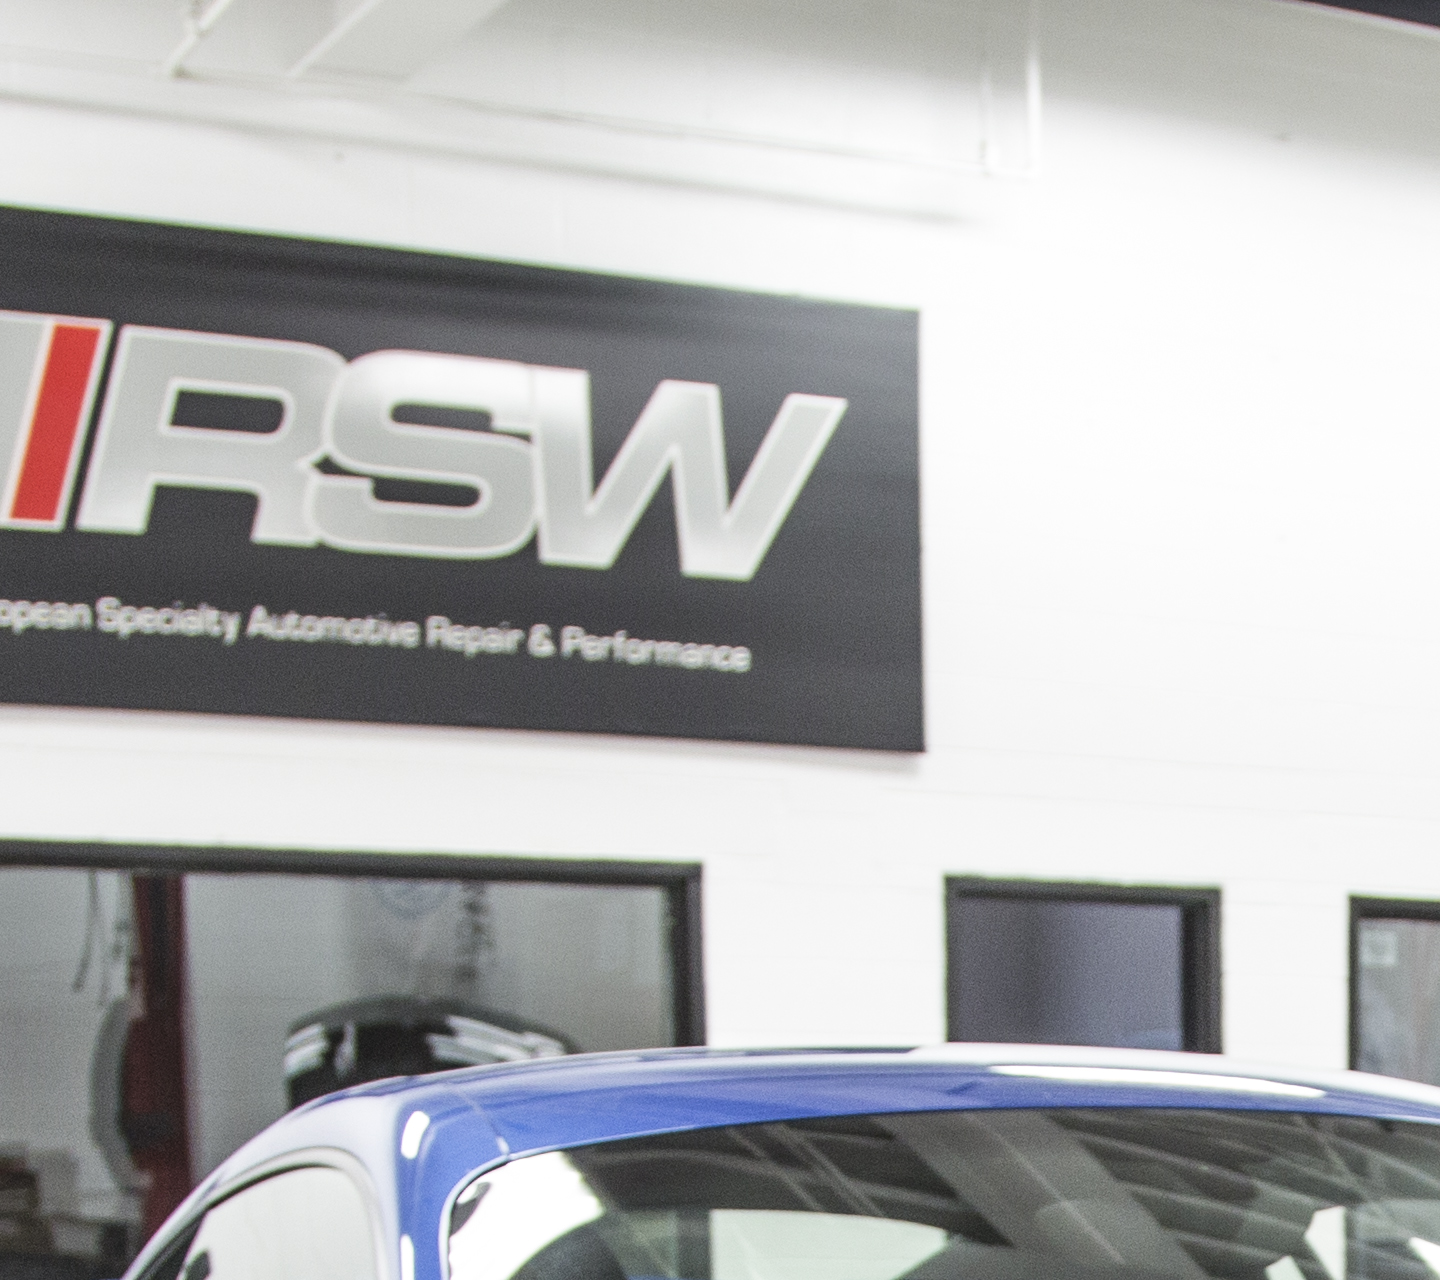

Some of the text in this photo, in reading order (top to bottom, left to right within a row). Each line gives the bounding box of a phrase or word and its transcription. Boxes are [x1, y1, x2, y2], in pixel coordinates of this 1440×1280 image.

[75, 324, 848, 581] RSW
[94, 595, 242, 646] Specialty
[245, 605, 421, 649] Automotive
[425, 614, 526, 658] Repair
[527, 622, 557, 659] &
[560, 625, 753, 674] Performance
